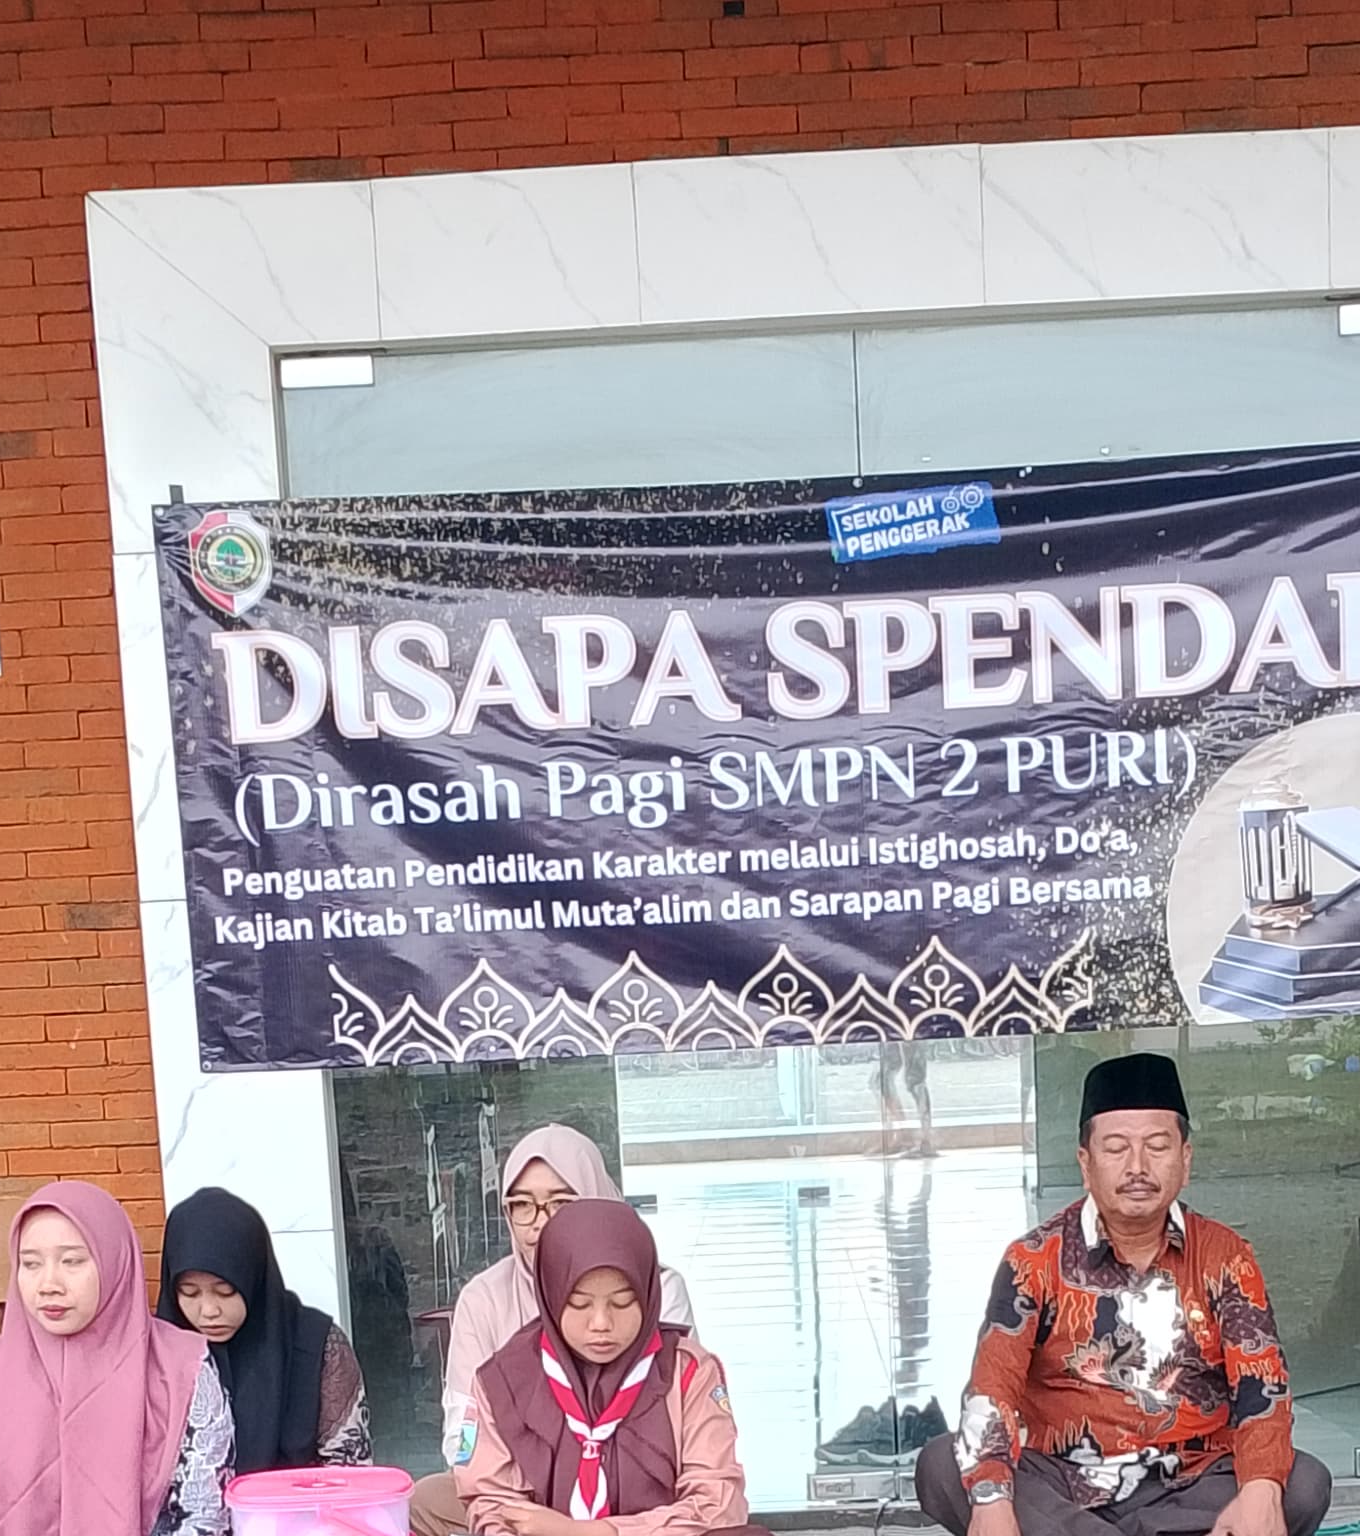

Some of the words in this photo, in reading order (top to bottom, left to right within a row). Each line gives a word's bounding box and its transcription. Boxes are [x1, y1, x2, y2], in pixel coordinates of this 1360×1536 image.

[841, 495, 936, 532] SEKOLAH
[846, 511, 971, 558] PENGGERAK
[209, 608, 743, 747] DISAPA
[234, 764, 521, 848] (Dirasah
[540, 756, 687, 829] Pagi
[707, 742, 917, 811] SMPN
[939, 738, 979, 797] 2
[1000, 727, 1198, 801] PURI)
[222, 865, 395, 901] Penguatan
[405, 851, 583, 888] Pendidikan
[591, 845, 732, 880] Karakter
[739, 836, 859, 873] melalui
[869, 828, 1046, 870] Istighosah,
[214, 914, 314, 950] Kajian
[322, 906, 407, 939] Kitab
[720, 891, 781, 921] dan
[789, 885, 923, 920] Sarapan
[932, 877, 1001, 915] Pagi
[1010, 873, 1153, 906] Bersama
